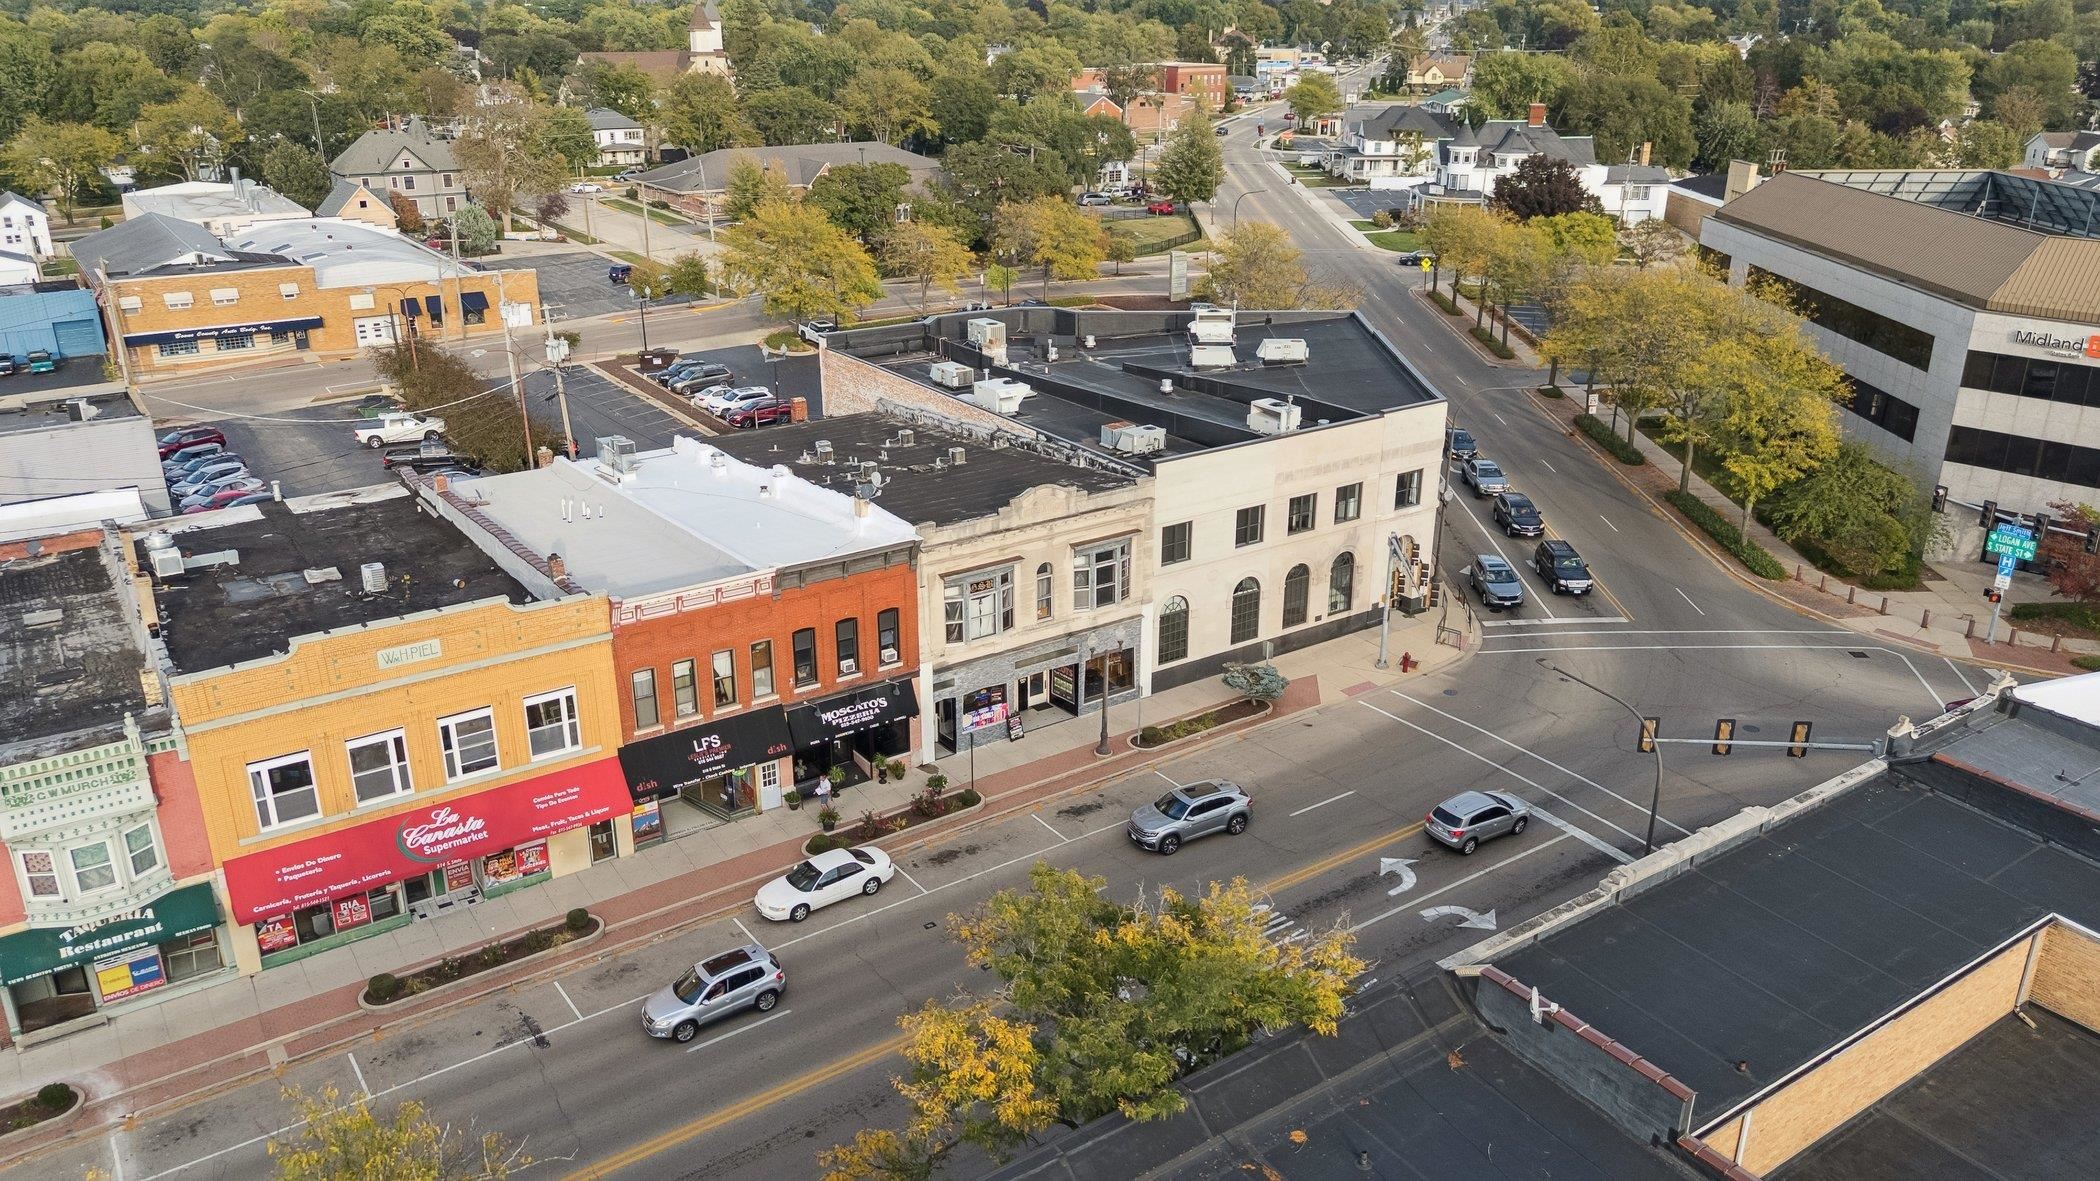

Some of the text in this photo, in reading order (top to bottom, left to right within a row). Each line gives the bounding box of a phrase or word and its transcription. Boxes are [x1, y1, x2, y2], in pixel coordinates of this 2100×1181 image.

[2015, 330, 2085, 351] Midland
[1987, 541, 2024, 558] S STATE ST
[1998, 535, 2036, 551] LOGAN AVE
[2002, 556, 2013, 568] H
[410, 643, 438, 659] PIEL
[820, 697, 888, 725] MOSCATO'S
[831, 708, 880, 726] PIZZERIA
[693, 734, 721, 752] LFS
[767, 743, 787, 755] dish
[60, 777, 109, 795] MURCH
[636, 779, 658, 792] dish
[430, 806, 460, 828] La
[590, 806, 610, 816] Liquor
[403, 816, 485, 849] Canasta
[423, 830, 489, 855] Supermarket
[317, 853, 342, 864] Dinero
[58, 921, 164, 959] Restaurant
[140, 978, 165, 990] DINERO
